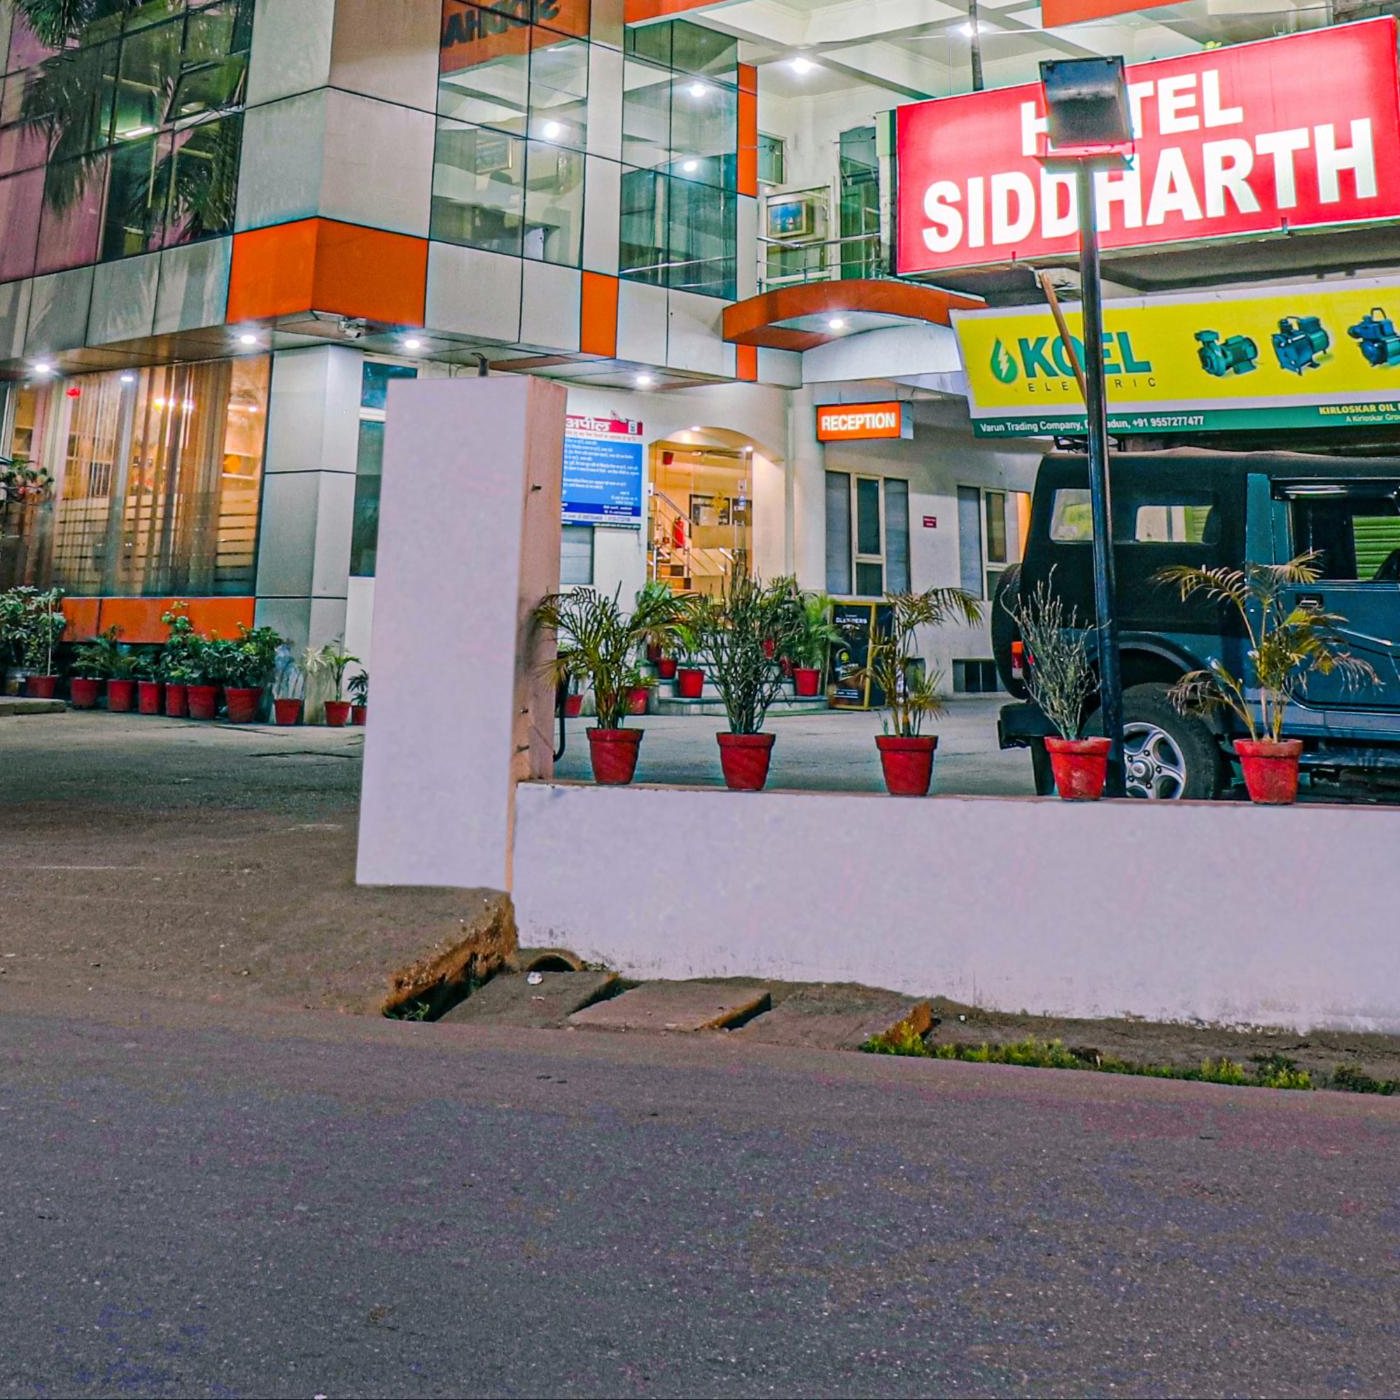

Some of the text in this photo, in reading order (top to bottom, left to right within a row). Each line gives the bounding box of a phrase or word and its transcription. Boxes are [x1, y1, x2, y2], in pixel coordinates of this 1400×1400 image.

[1021, 69, 1244, 157] HTEL
[922, 118, 1378, 253] SIDDHARTH
[1027, 376, 1156, 393] ELERIC
[1319, 403, 1376, 415] KIRLOSKAR
[1378, 403, 1396, 412] OIL
[821, 412, 896, 432] RECEPTION
[980, 423, 1005, 433] Varun
[1005, 421, 1038, 433] Trading
[1040, 420, 1083, 432] Company,
[1132, 418, 1148, 429] +91
[1150, 416, 1204, 428] 9557277477
[1352, 414, 1384, 422] Kirloskar
